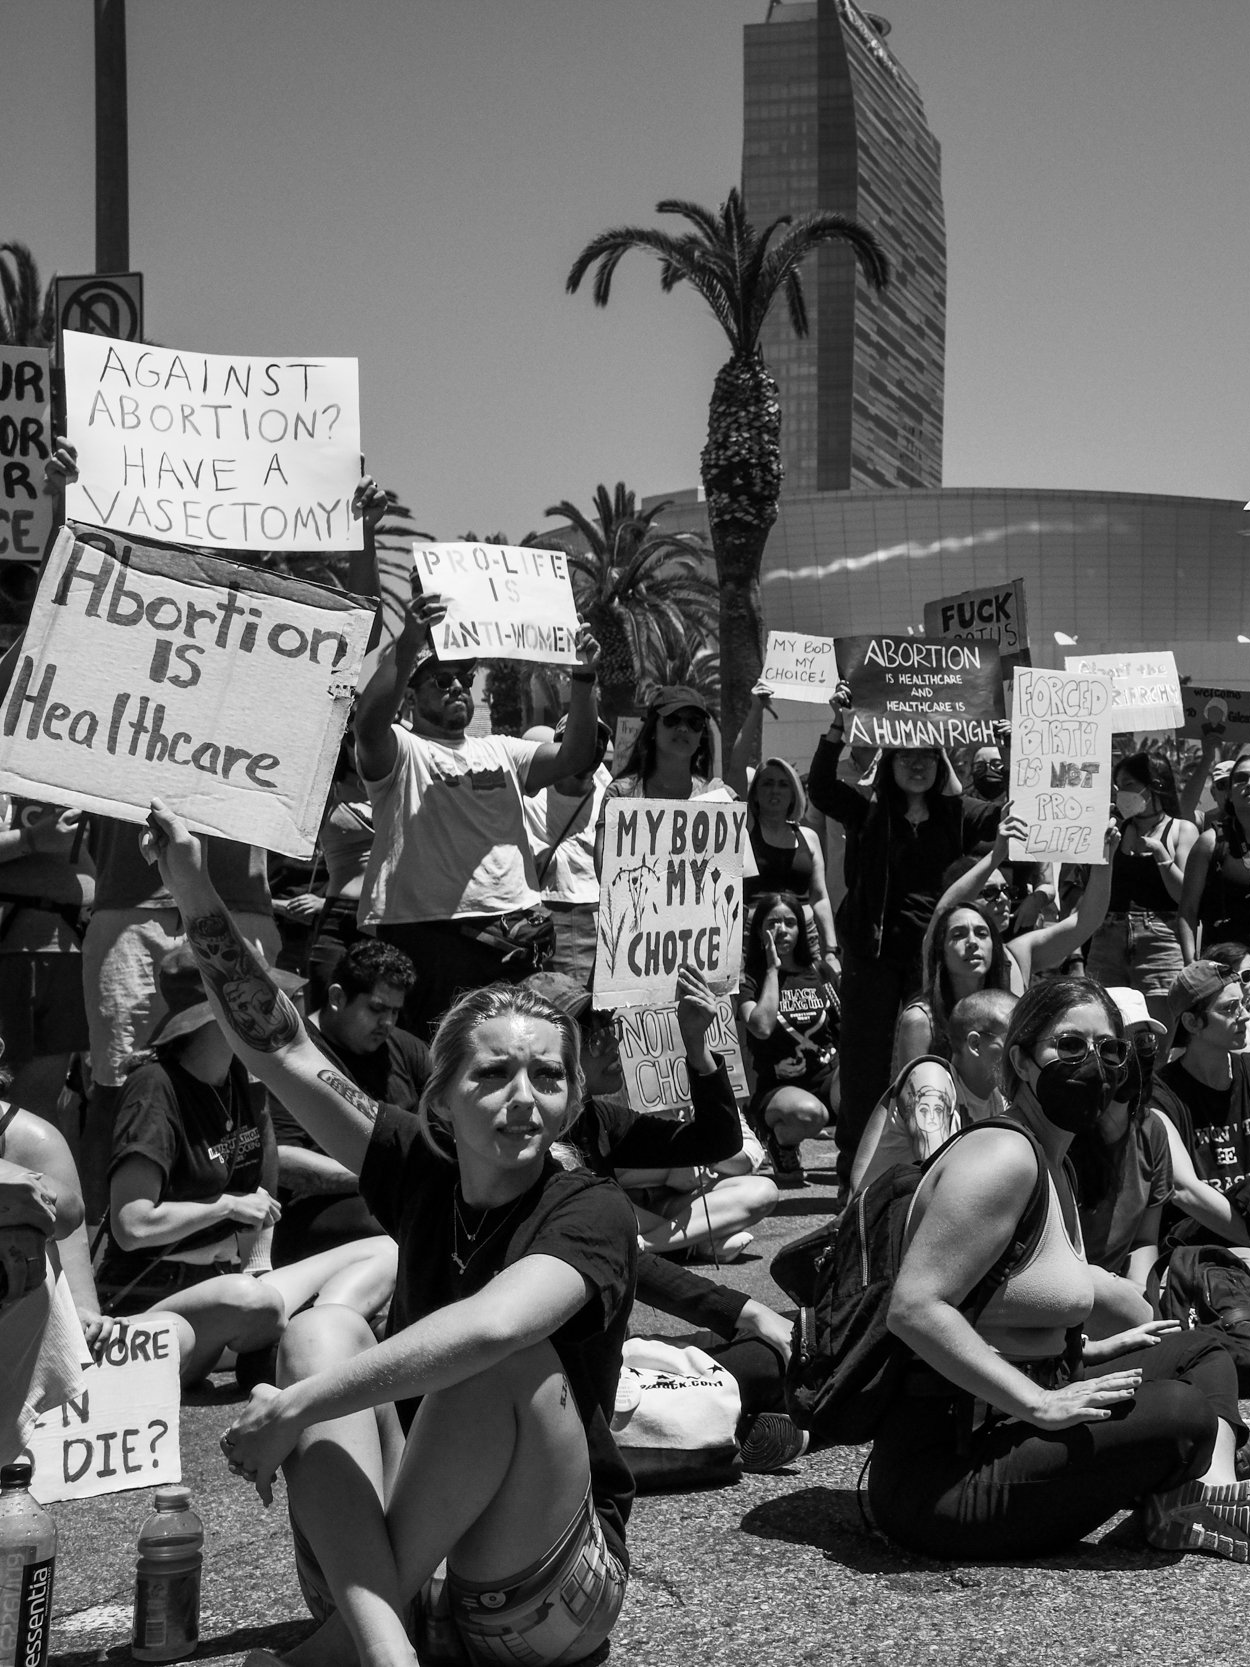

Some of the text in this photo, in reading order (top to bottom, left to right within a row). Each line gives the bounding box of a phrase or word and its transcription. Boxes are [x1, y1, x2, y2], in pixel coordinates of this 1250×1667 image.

[100, 346, 327, 402] AGAINST
[88, 390, 341, 443] ABORTION?
[124, 444, 288, 492] HAVE A
[83, 485, 352, 542] VASECTOMY!
[422, 547, 566, 580] PRO-LIFE
[52, 532, 348, 667] Abortion
[489, 578, 520, 603] IS
[941, 591, 1013, 633] FUCK
[443, 621, 576, 653] ANTI-WOMEN
[773, 638, 797, 653] MY
[795, 656, 815, 670] MY
[864, 639, 981, 670] ABORTION
[765, 667, 826, 684] CHOICE!
[886, 673, 963, 685] IS HEALTHCARE
[887, 700, 966, 712] HEALTHCARE IS
[911, 687, 933, 698] AND
[1018, 671, 1109, 717] FORCED
[3, 655, 281, 788] Healthcare
[850, 715, 872, 745] A
[874, 717, 944, 748] HUMAN
[1018, 718, 1098, 757] BIRTH
[1017, 758, 1100, 788] IS NOT
[1035, 793, 1095, 821] PRO-
[616, 809, 746, 857] MY BODY
[1025, 824, 1092, 855] LIFE
[666, 859, 709, 906] MY
[627, 926, 721, 977] CHOICE
[780, 1000, 808, 1012] FLAG
[781, 988, 816, 1001] BLACK
[619, 1007, 677, 1058] NOT
[63, 1419, 168, 1484] DIE?
[25, 1566, 48, 1667] essentia
